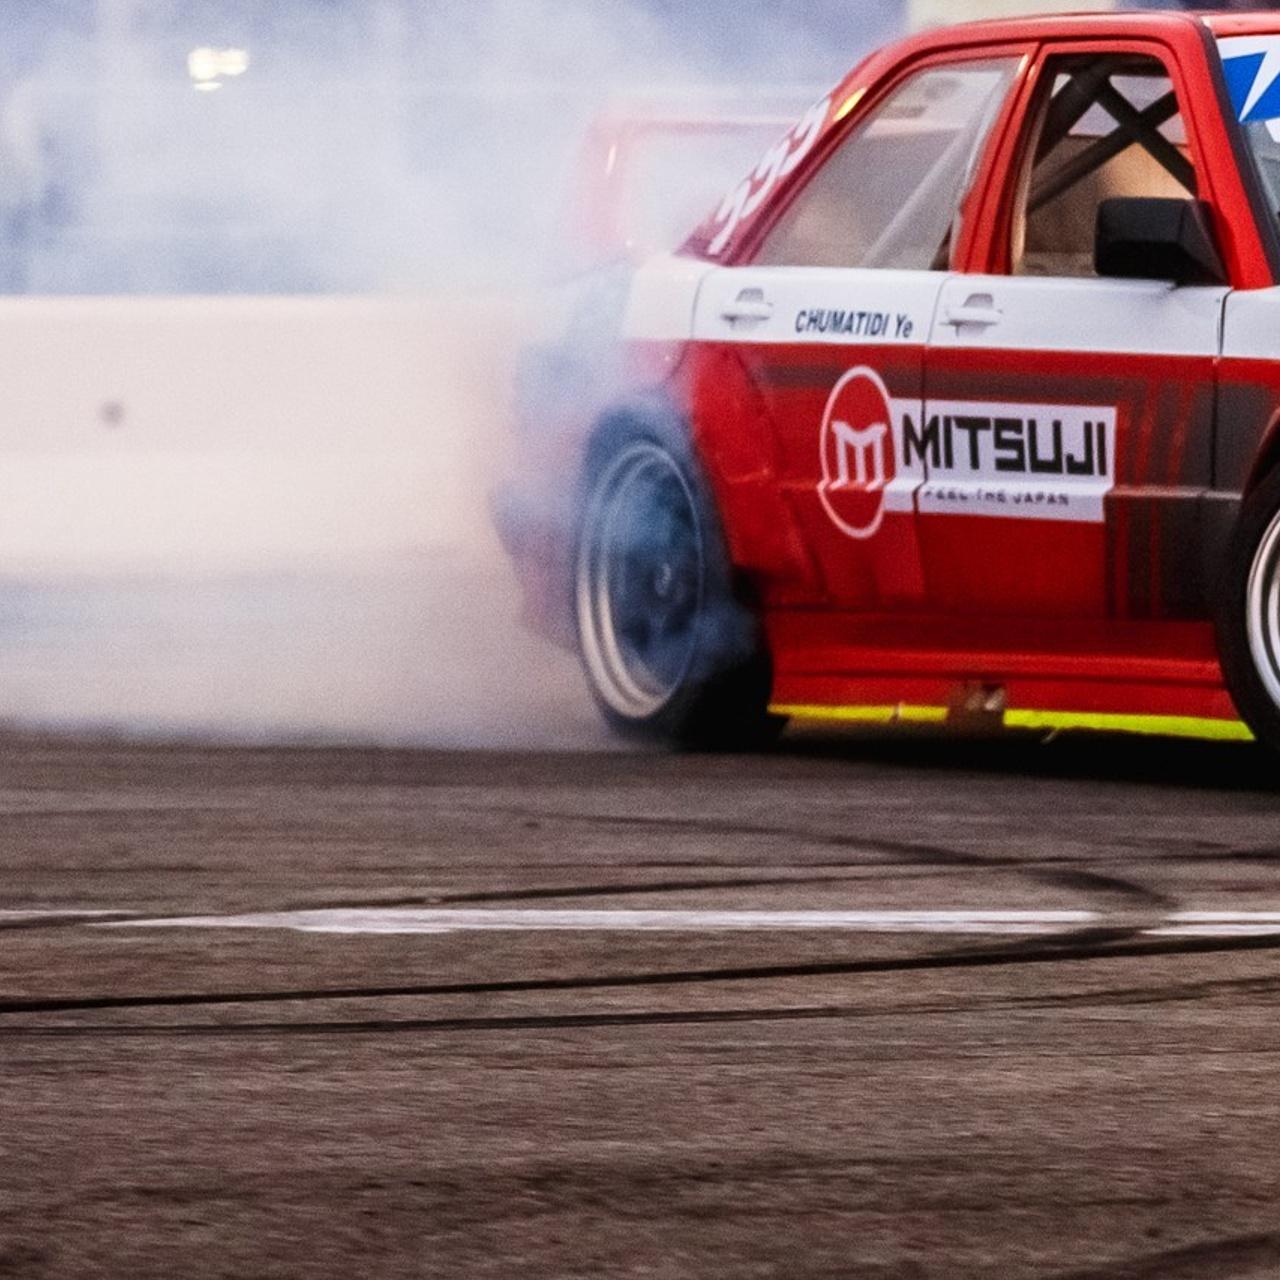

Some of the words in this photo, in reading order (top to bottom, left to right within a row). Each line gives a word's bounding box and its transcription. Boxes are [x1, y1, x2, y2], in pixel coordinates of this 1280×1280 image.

[795, 310, 890, 336] CHUMATIDI
[895, 314, 913, 338] Ye
[903, 414, 1106, 477] MITSUJI
[1013, 491, 1069, 505] JAPAN
